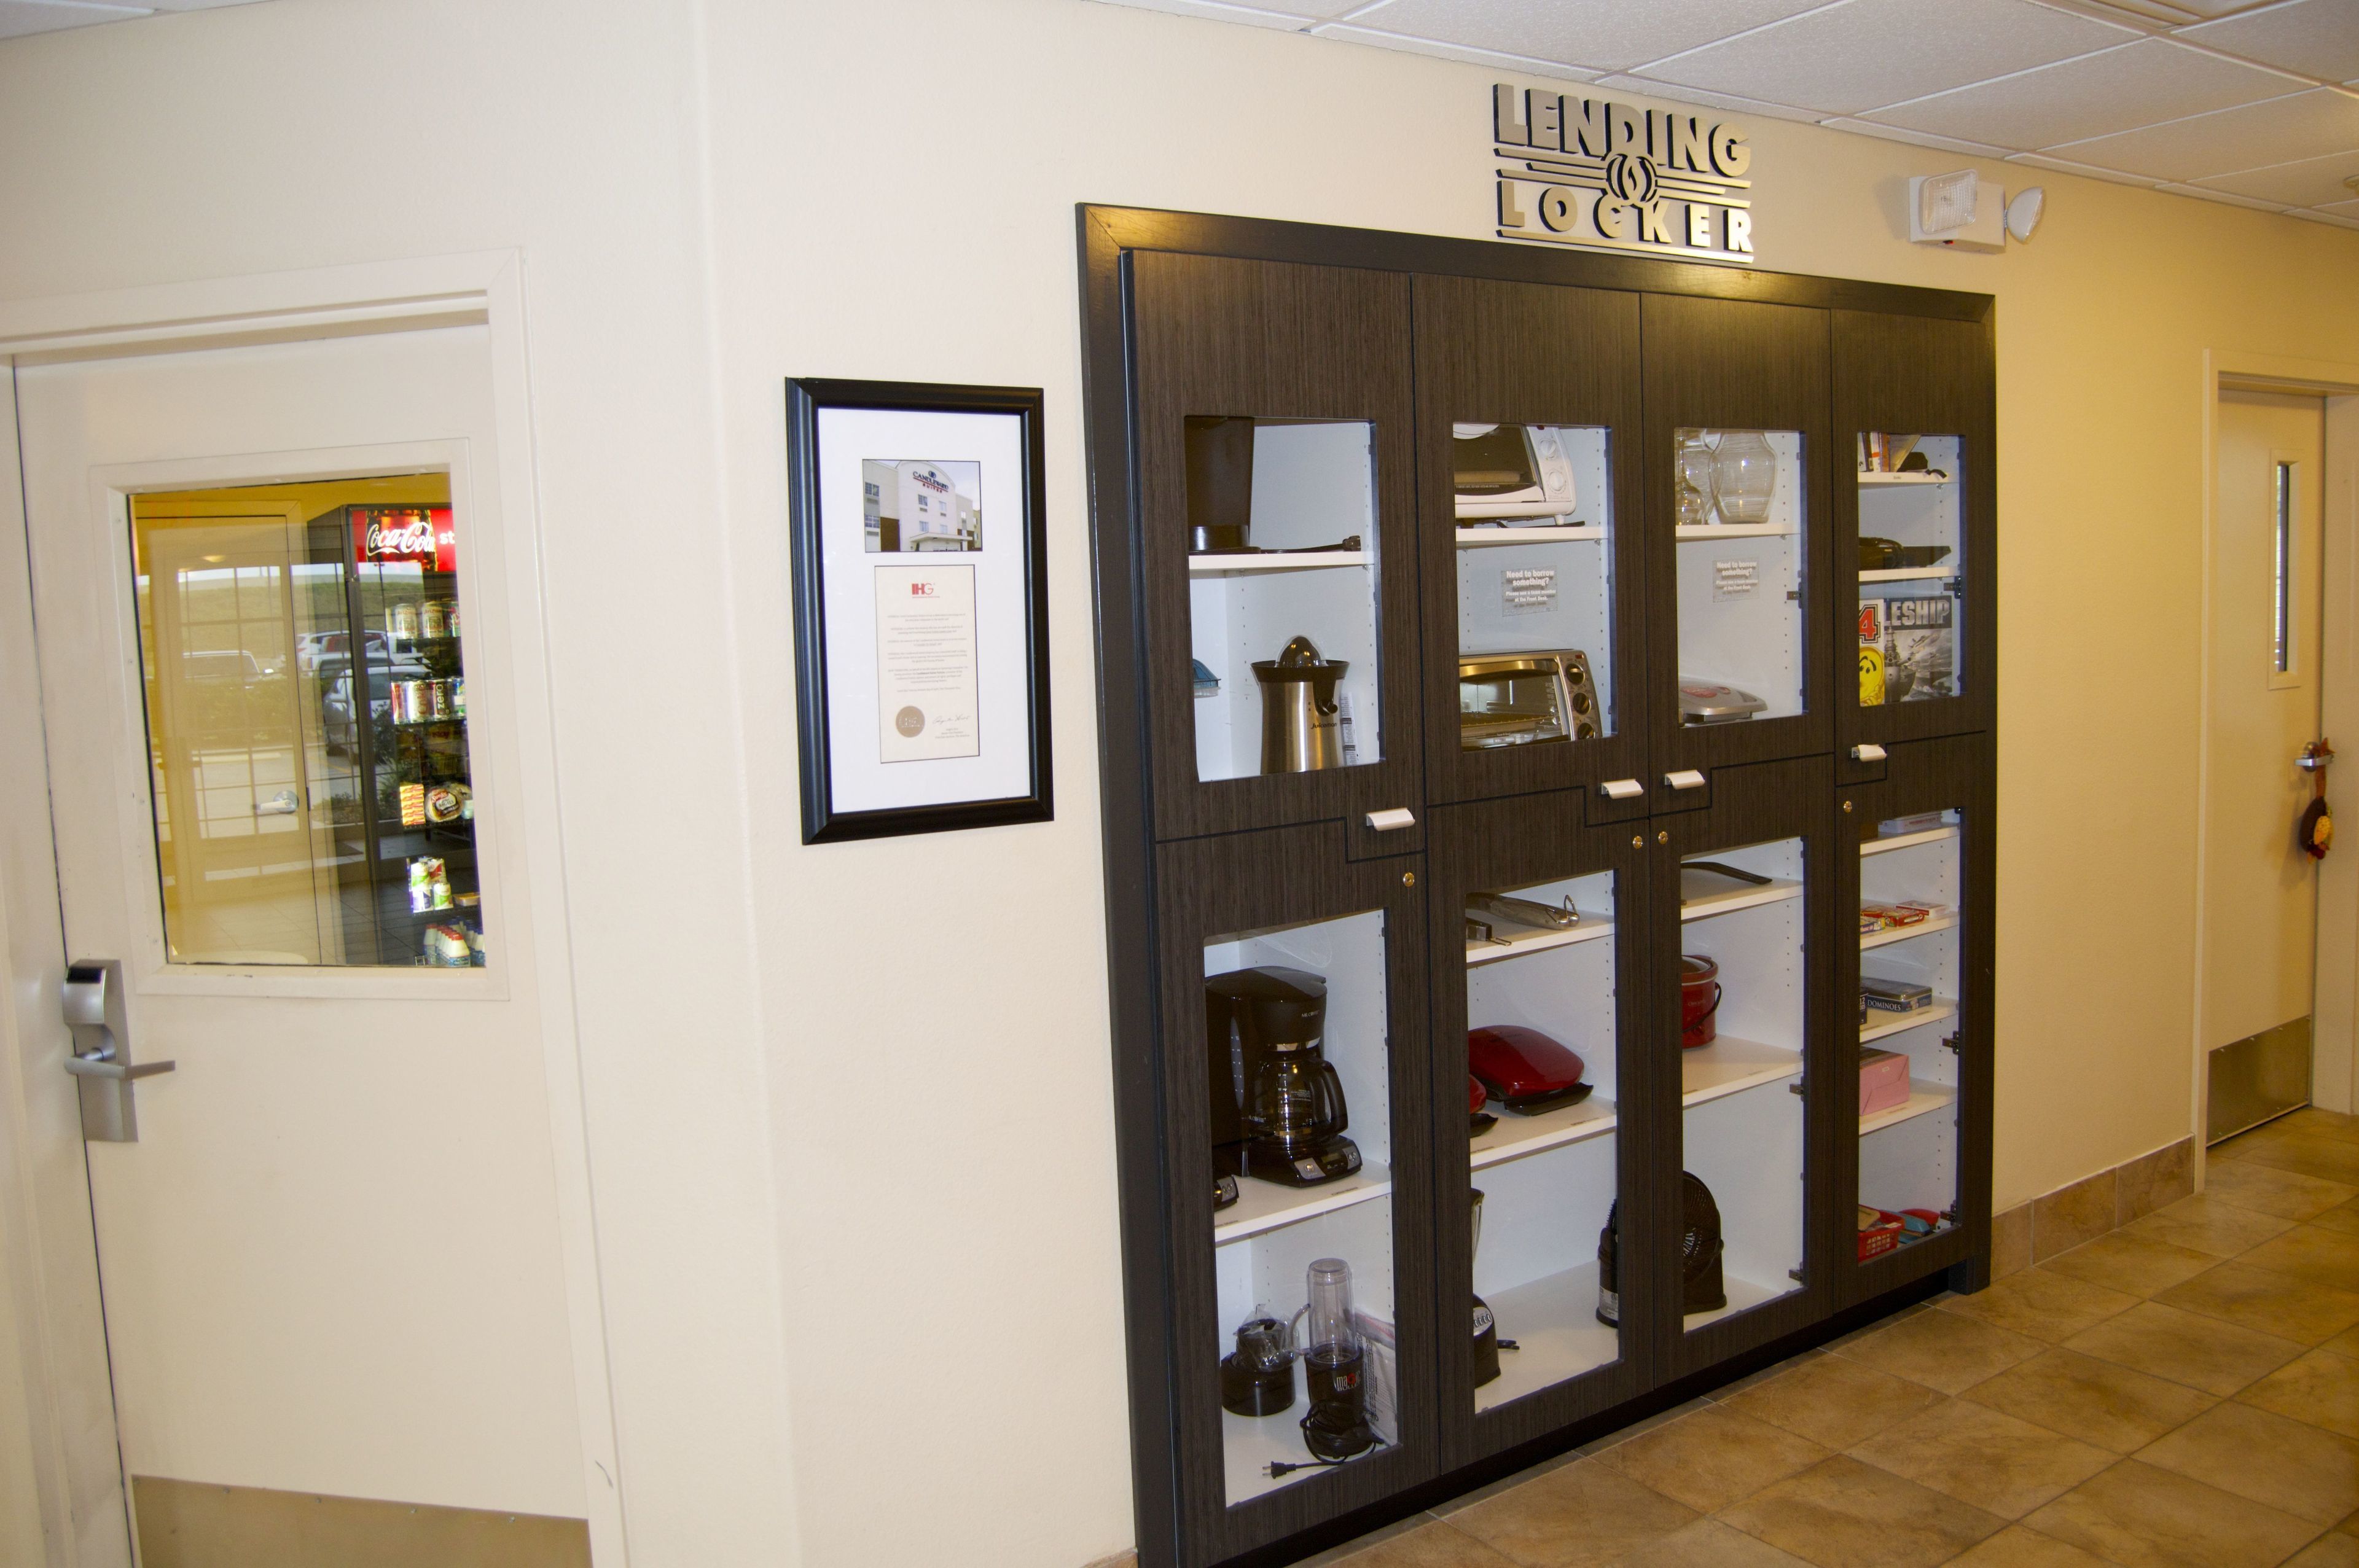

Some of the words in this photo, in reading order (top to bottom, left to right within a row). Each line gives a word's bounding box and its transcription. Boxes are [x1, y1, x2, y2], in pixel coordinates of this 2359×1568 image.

[1493, 84, 1751, 177] LENDING
[1497, 180, 1754, 252] LOCKER
[367, 521, 436, 556] Coca-Cola
[912, 583, 934, 595] IHG
[1512, 577, 1549, 586] something?
[1859, 605, 1880, 643] 4
[436, 684, 445, 709] zero
[1868, 999, 1901, 1012] DOMINOES
